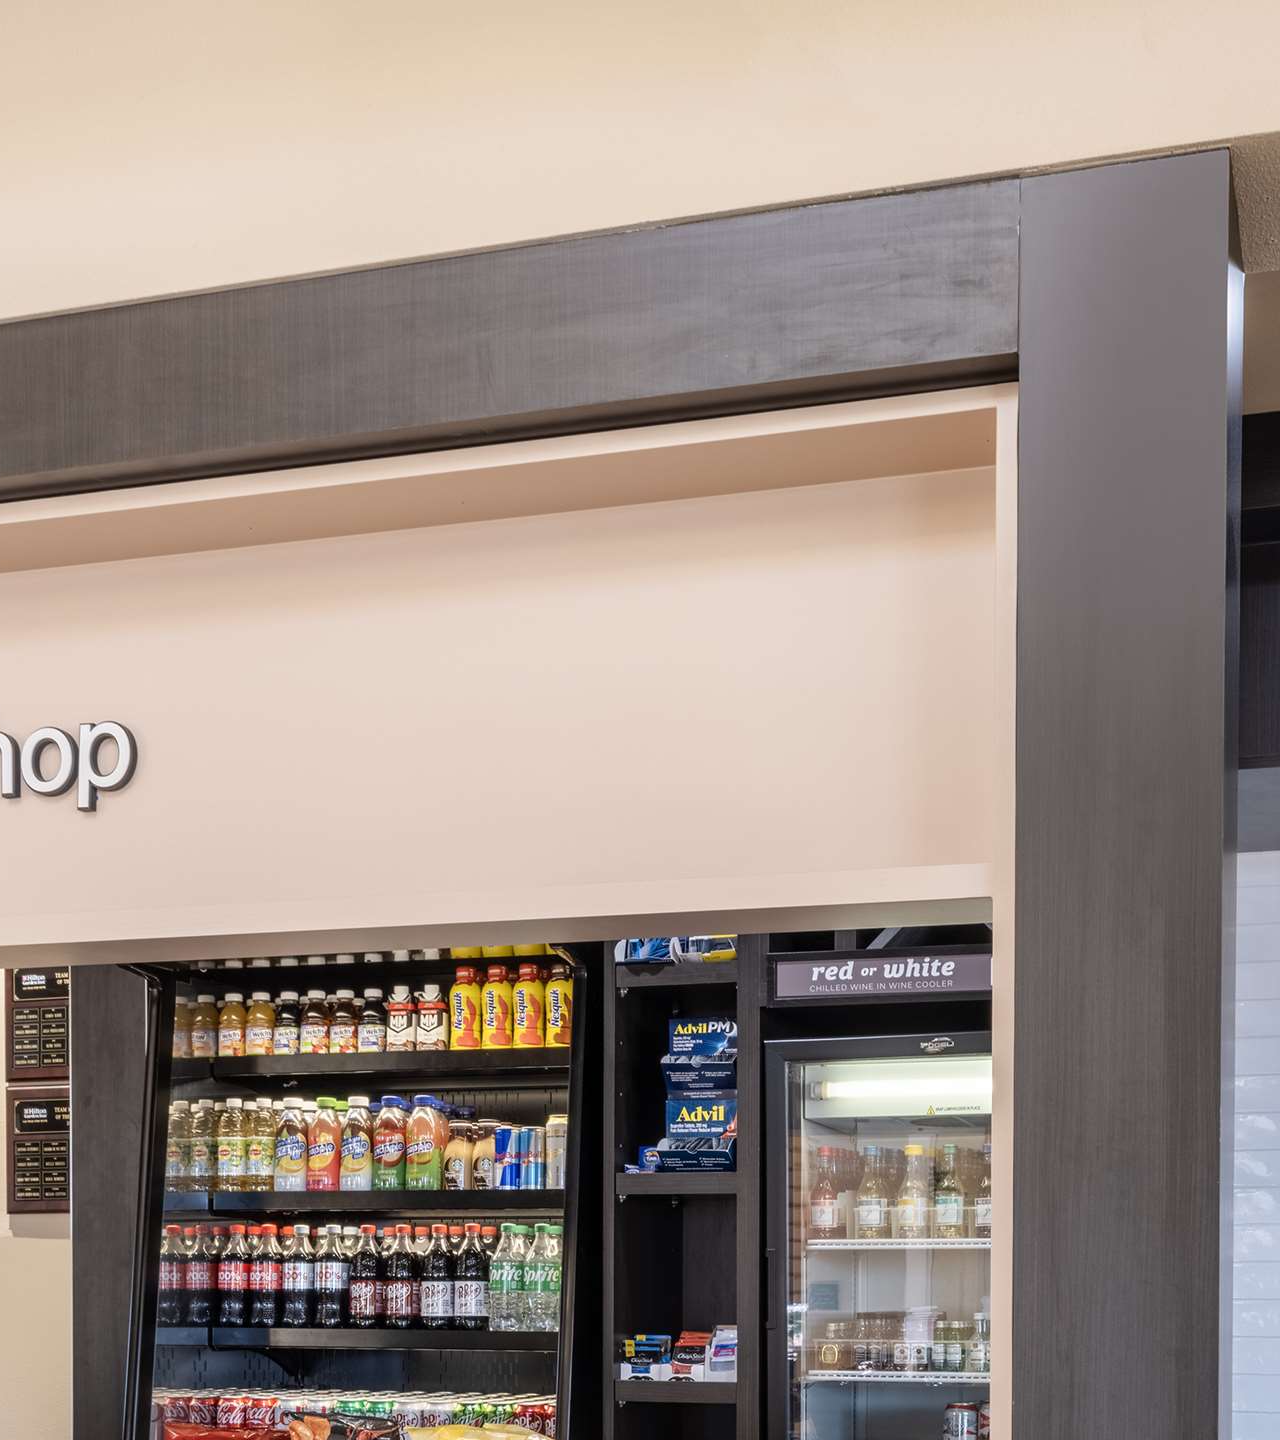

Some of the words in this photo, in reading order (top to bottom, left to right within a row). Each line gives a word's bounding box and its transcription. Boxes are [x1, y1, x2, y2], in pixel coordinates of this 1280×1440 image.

[812, 960, 854, 982] red
[861, 965, 877, 977] or
[883, 957, 955, 978] white
[809, 983, 848, 993] CHILLED
[850, 983, 873, 991] WINE
[876, 982, 886, 990] IN
[888, 981, 913, 990] WINE
[915, 979, 953, 988] COOLER
[454, 992, 463, 1030] Nesquik
[486, 990, 497, 1028] Nesquik
[517, 989, 528, 1027] Nesquik
[550, 988, 563, 1027] Nesquik
[674, 1022, 708, 1035] Advil
[708, 1021, 730, 1033] PM
[676, 1104, 725, 1122] Advil
[523, 1263, 560, 1285] Sprite
[217, 1403, 245, 1425] Cola
